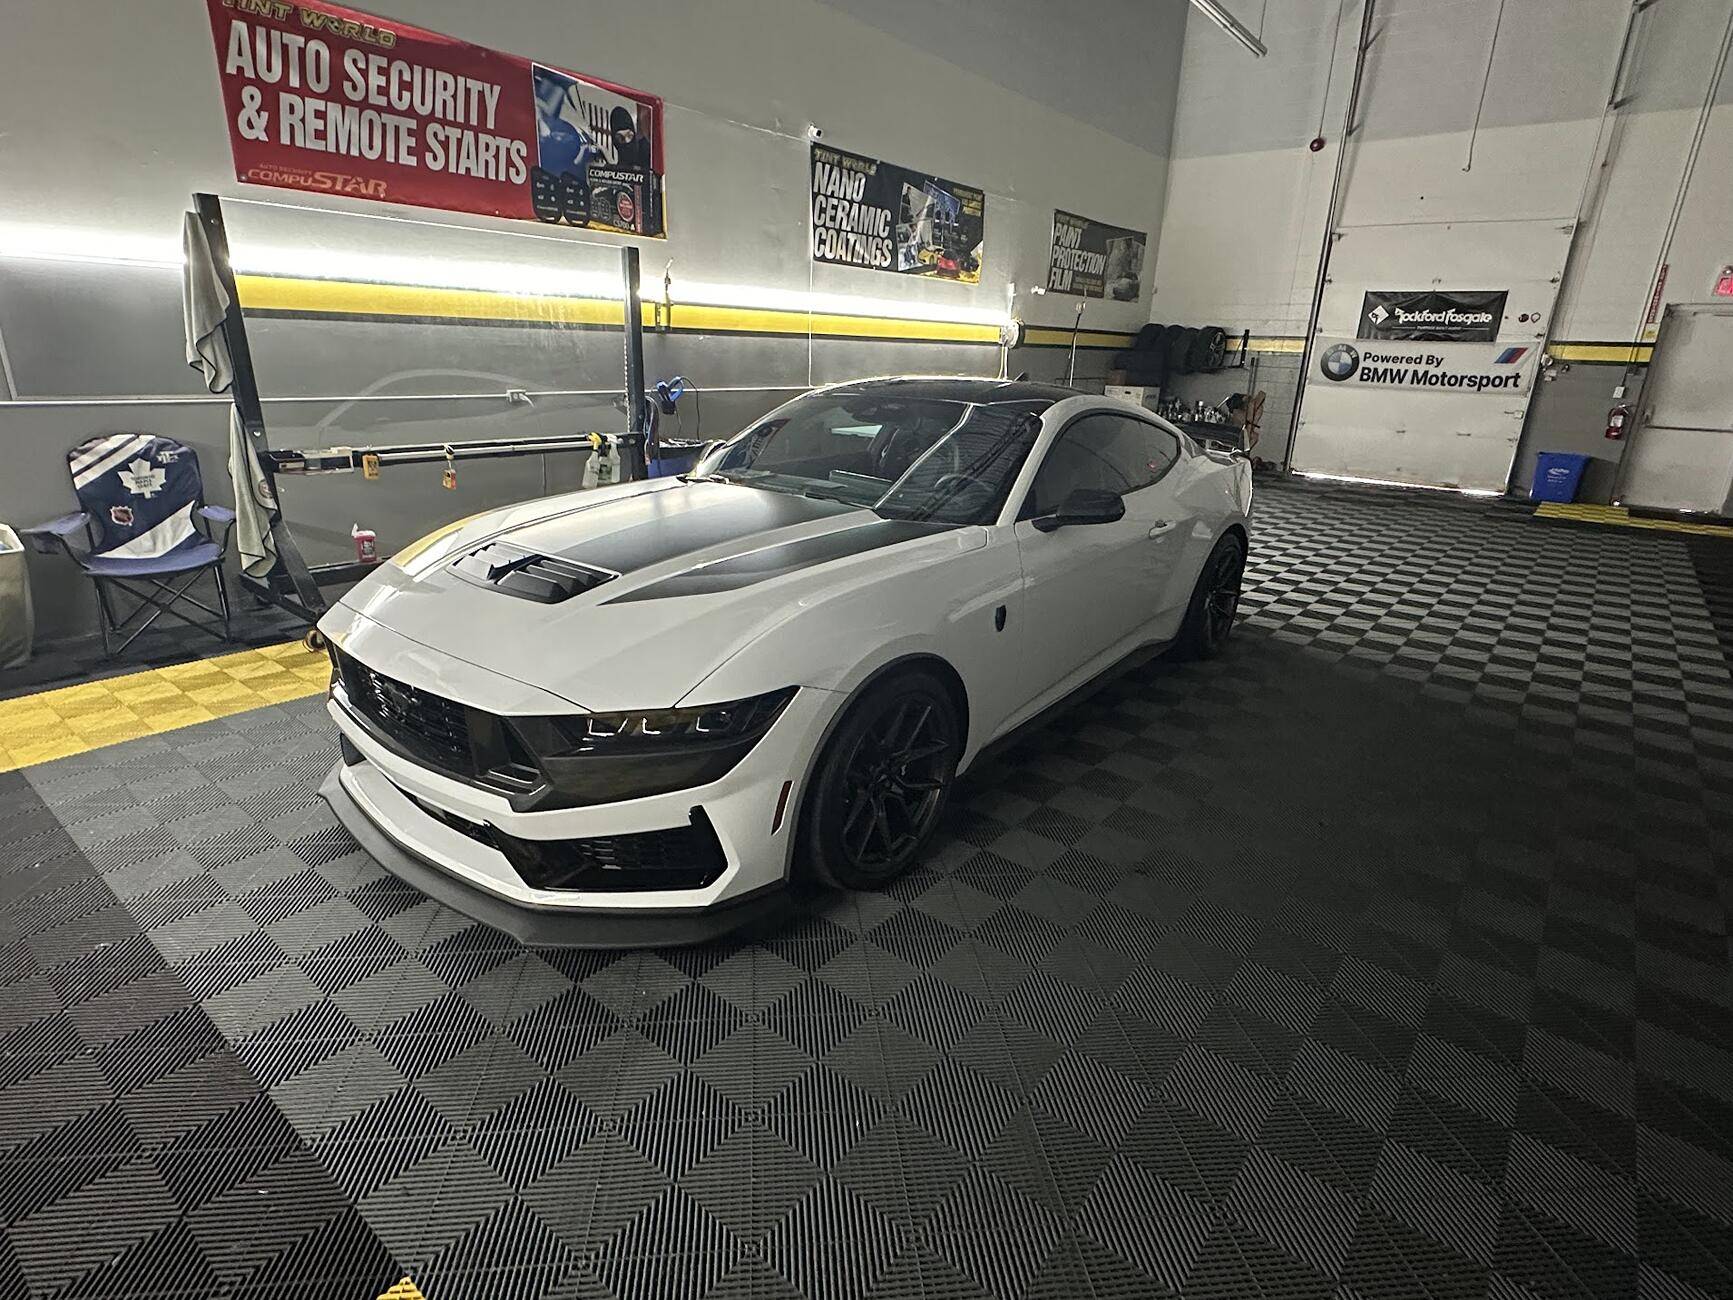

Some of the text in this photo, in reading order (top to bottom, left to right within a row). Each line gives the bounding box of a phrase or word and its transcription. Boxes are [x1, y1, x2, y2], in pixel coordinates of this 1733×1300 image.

[300, 8, 396, 48] WORLD
[226, 19, 501, 130] AUTO SECURITY
[237, 86, 527, 185] & REMOTE STARTS
[589, 168, 644, 183] COMPUSTAR
[813, 162, 866, 203] NANO
[814, 194, 892, 238] CERAMIC
[814, 227, 893, 268] COATINGS
[1054, 222, 1082, 249] PAINT
[1051, 245, 1107, 275] PROTECTION
[1049, 267, 1073, 291] FILM
[1394, 307, 1493, 325] Rockford Fosgate
[1363, 352, 1444, 368] Powered By
[1359, 367, 1521, 392] BMW Motorsport
